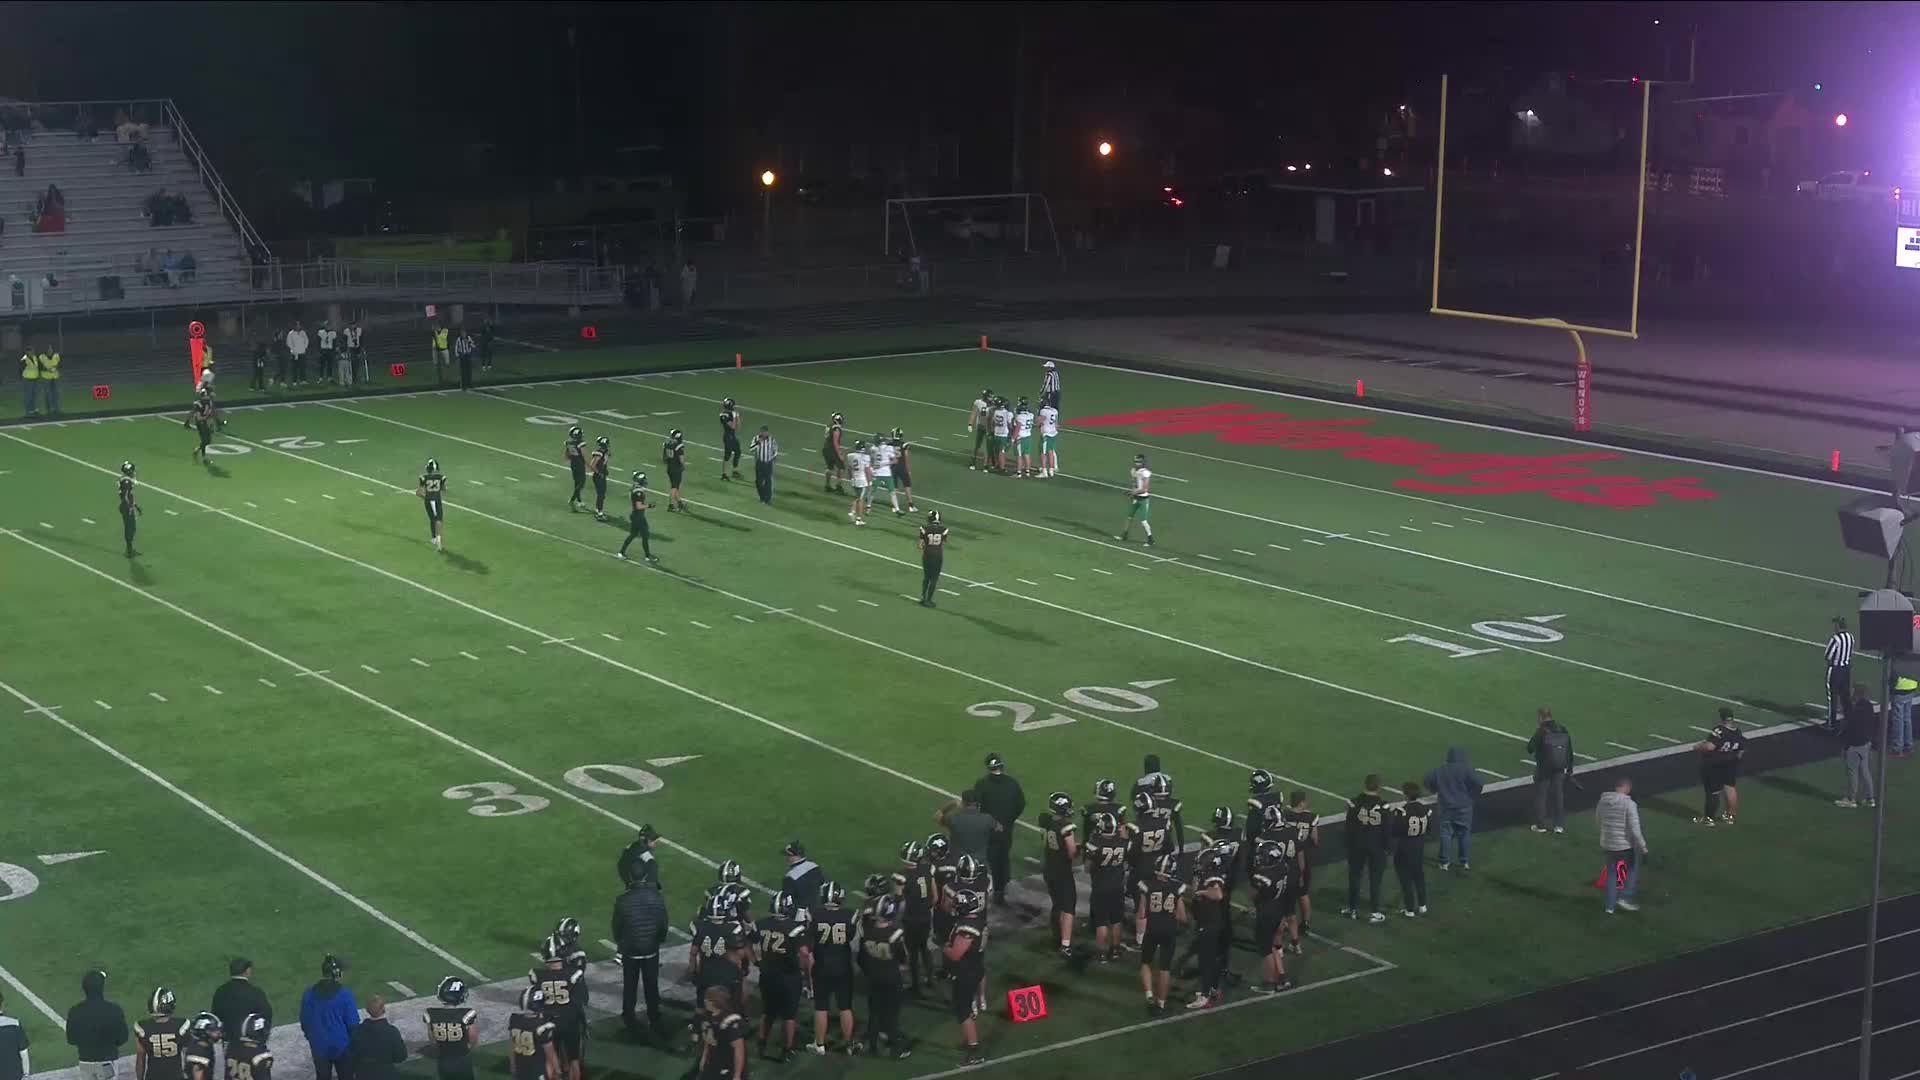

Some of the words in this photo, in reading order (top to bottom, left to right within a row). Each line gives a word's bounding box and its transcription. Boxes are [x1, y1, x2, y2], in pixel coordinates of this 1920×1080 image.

[1143, 829, 1165, 852] 52
[760, 929, 787, 954] 72
[817, 922, 847, 944] 76
[701, 935, 727, 957] 44
[1014, 991, 1041, 1018] 30
[149, 1033, 178, 1058] 15
